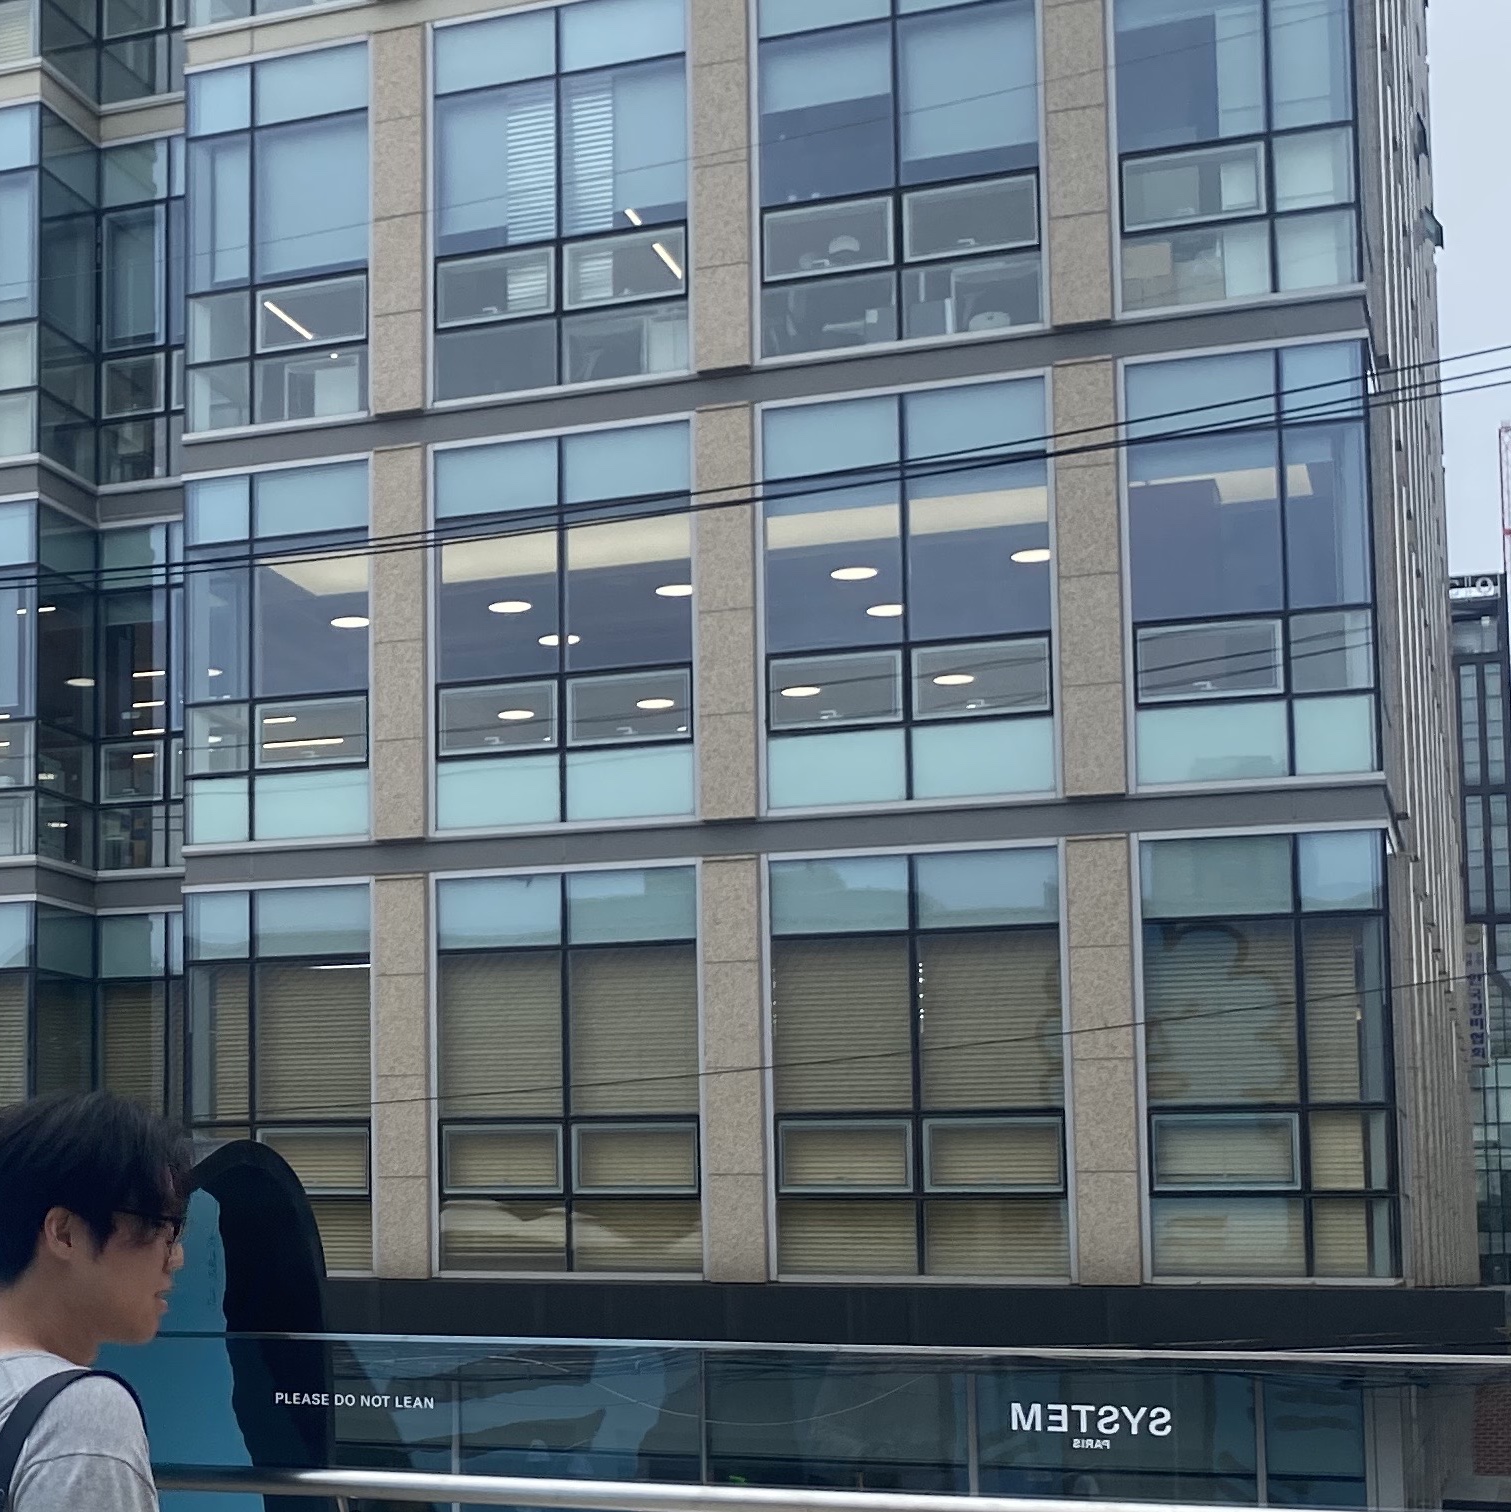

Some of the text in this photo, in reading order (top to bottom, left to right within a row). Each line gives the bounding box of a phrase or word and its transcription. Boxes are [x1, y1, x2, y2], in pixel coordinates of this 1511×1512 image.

[275, 1392, 435, 1410] PLEASE DO NOT LEAN
